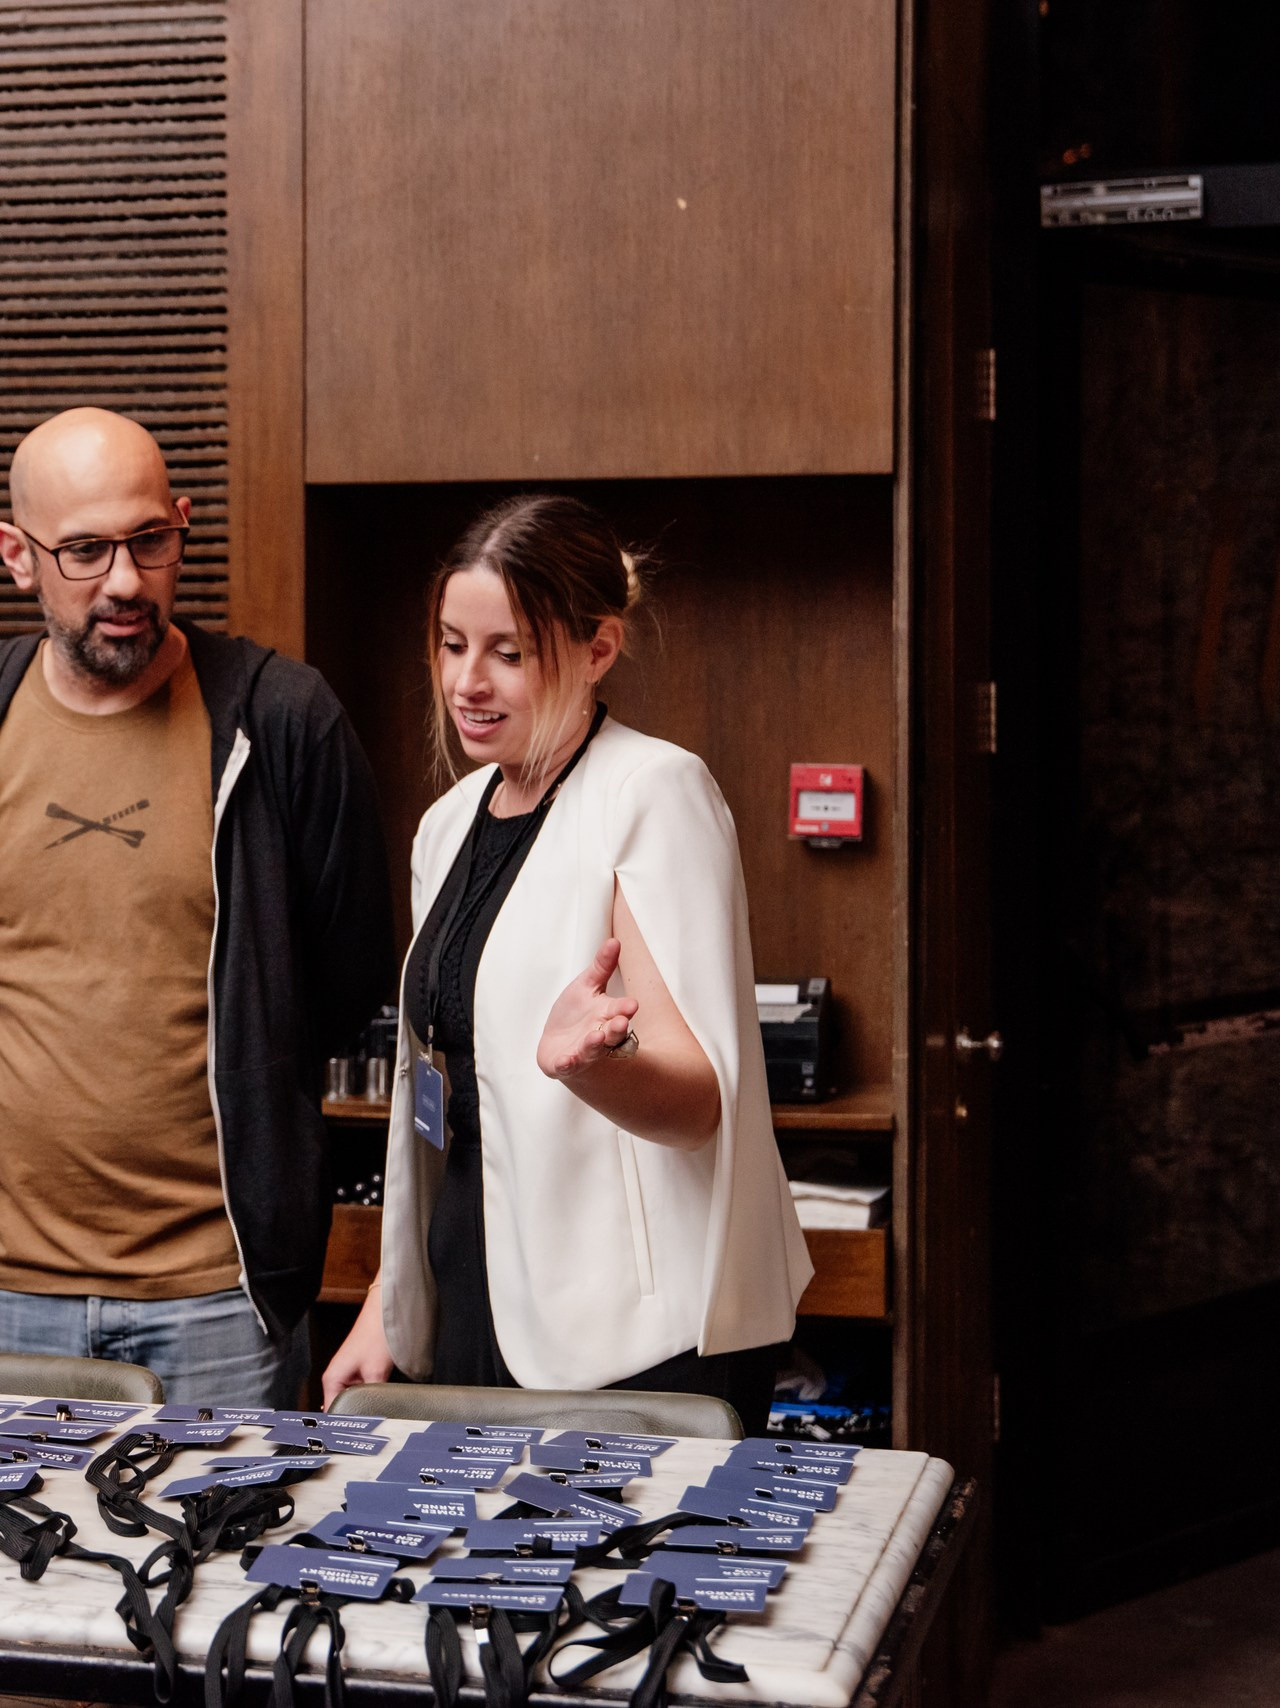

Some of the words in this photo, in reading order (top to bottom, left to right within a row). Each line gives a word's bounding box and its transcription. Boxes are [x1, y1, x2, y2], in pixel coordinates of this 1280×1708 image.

[420, 1467, 495, 1475] BEN-SHLOMI
[773, 1487, 824, 1497] ANDERS
[413, 1503, 465, 1512] BARNEA
[421, 1508, 466, 1517] TOMER
[355, 1529, 394, 1539] DAVID
[299, 1568, 378, 1582] BACHINSKY
[320, 1575, 375, 1587] SHMUEL
